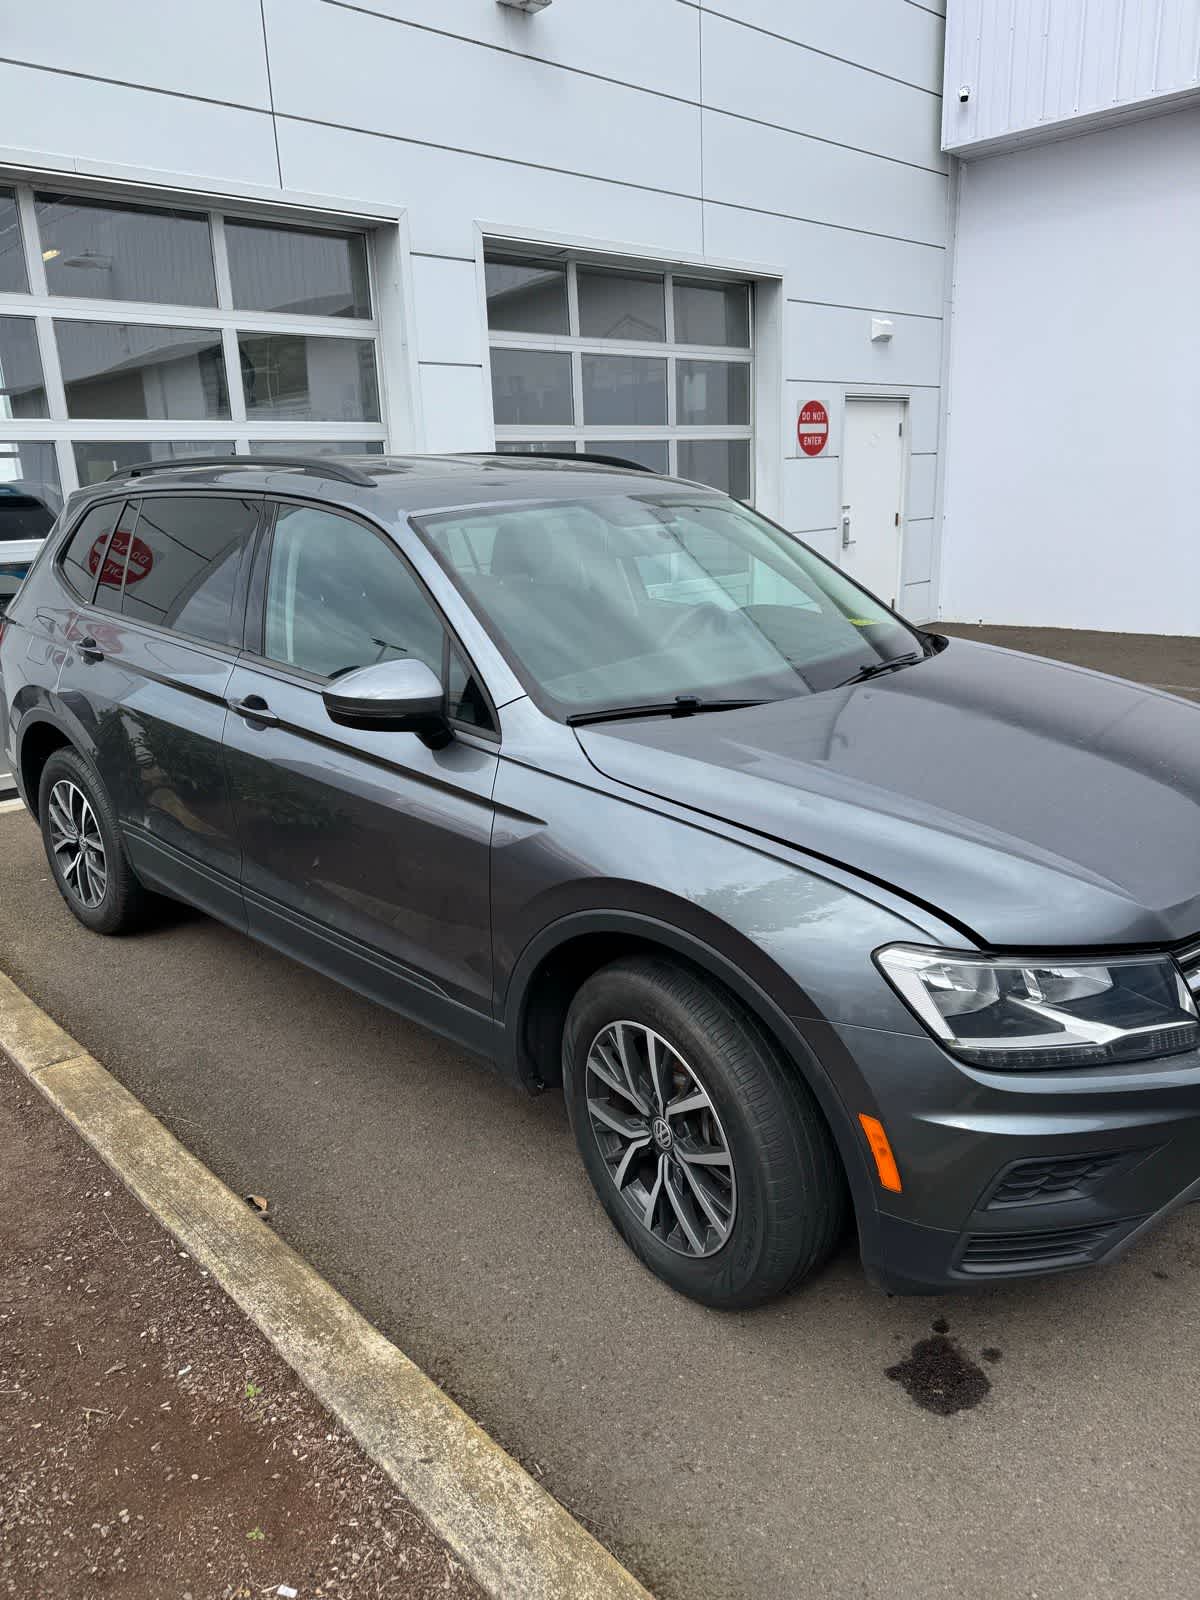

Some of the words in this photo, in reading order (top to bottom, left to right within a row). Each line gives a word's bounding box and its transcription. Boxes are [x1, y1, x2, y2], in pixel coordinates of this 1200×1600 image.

[802, 412, 811, 420] DO
[812, 412, 824, 420] NOT
[804, 436, 822, 446] ENTER
